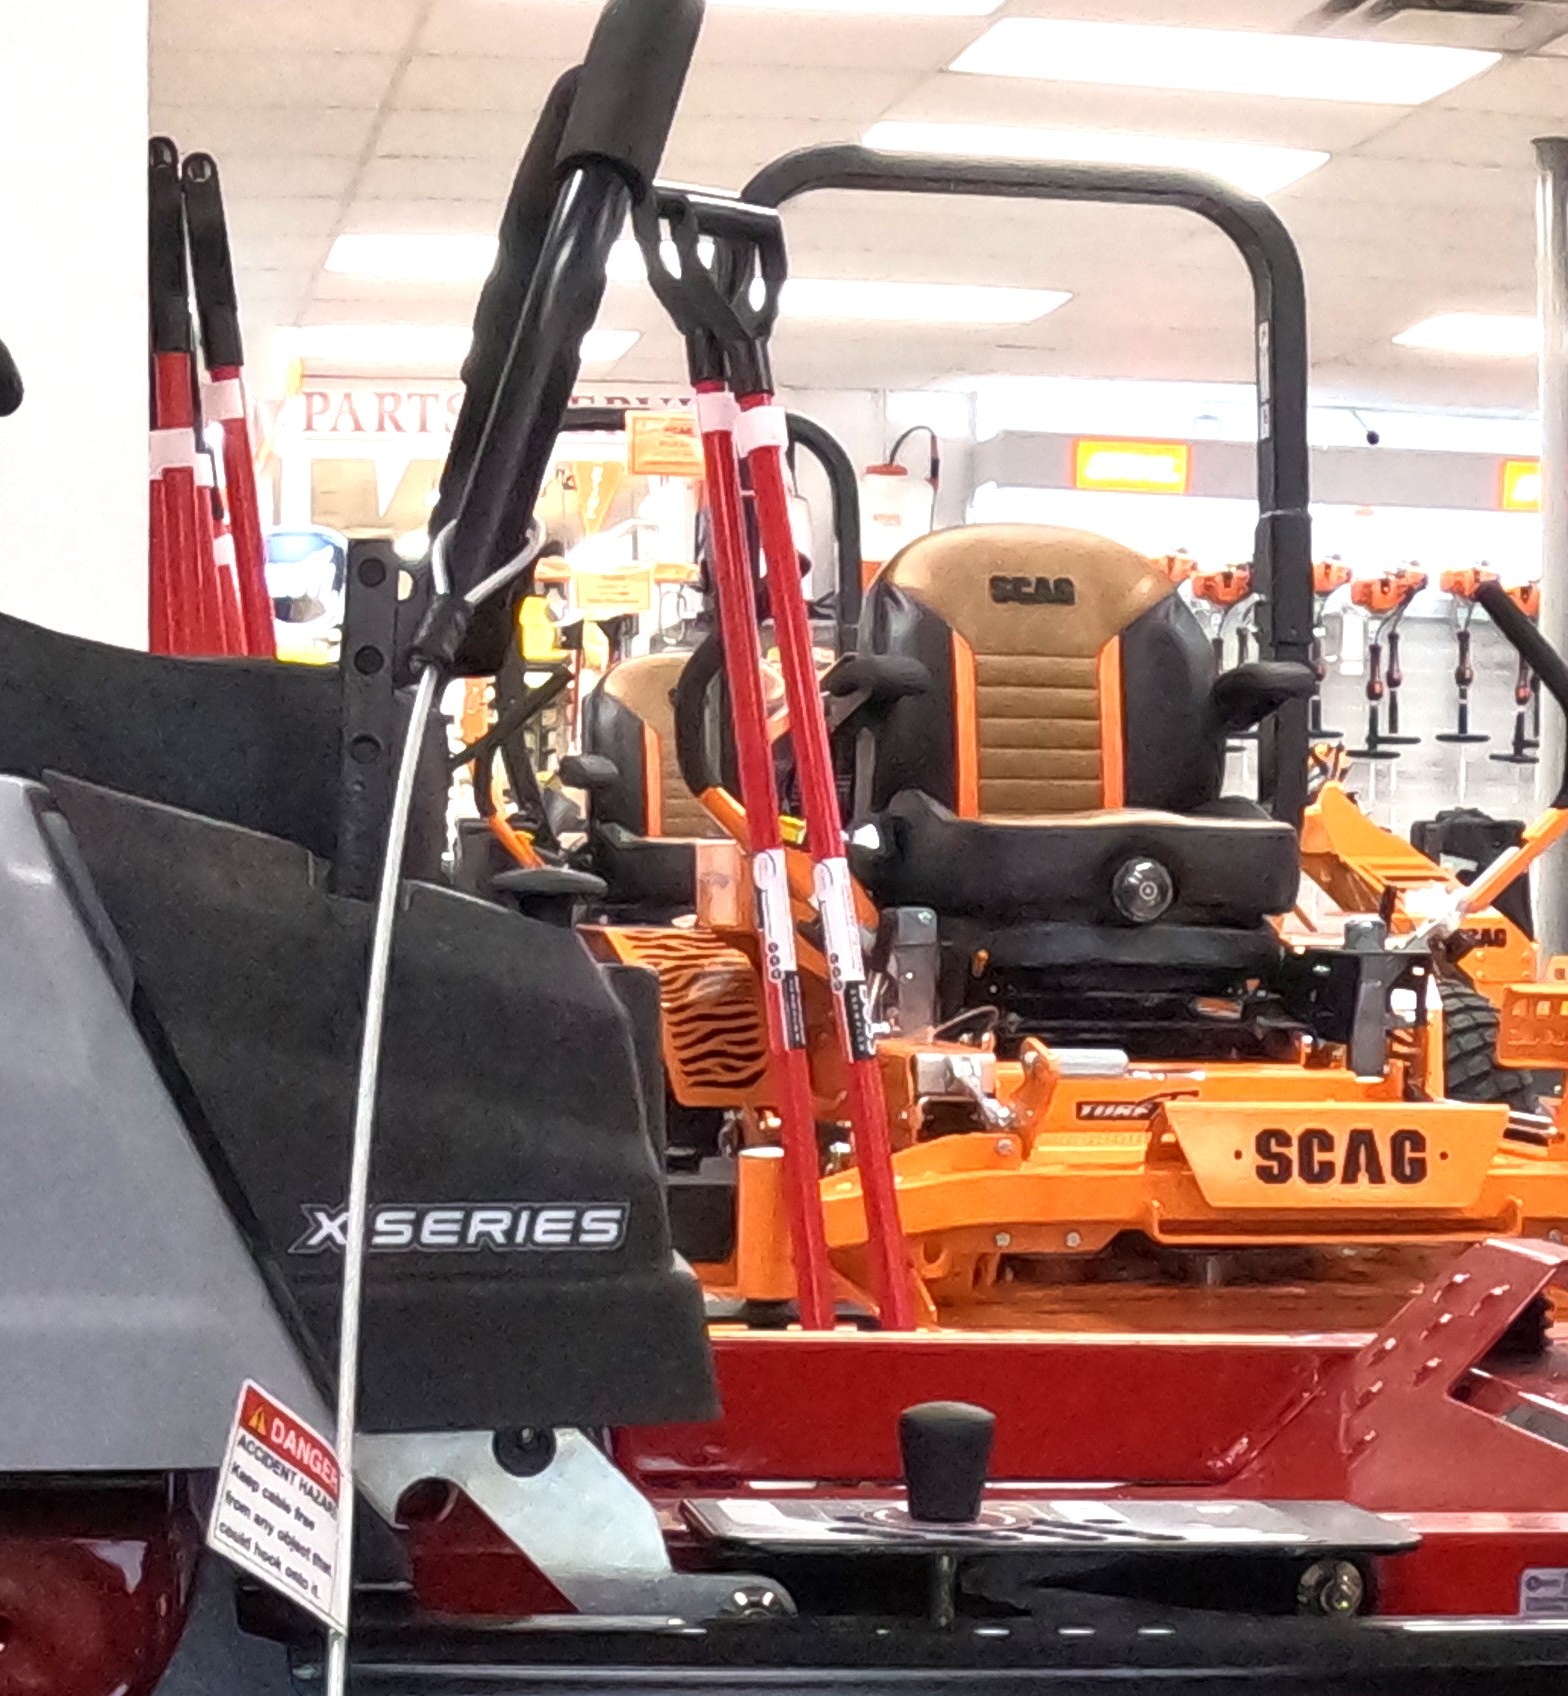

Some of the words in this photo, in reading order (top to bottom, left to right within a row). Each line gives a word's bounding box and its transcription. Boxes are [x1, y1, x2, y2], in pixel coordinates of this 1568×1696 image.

[1254, 1128, 1428, 1185] SCAG
[371, 1208, 623, 1245] SERIES
[237, 1434, 297, 1486] ACCIDENT
